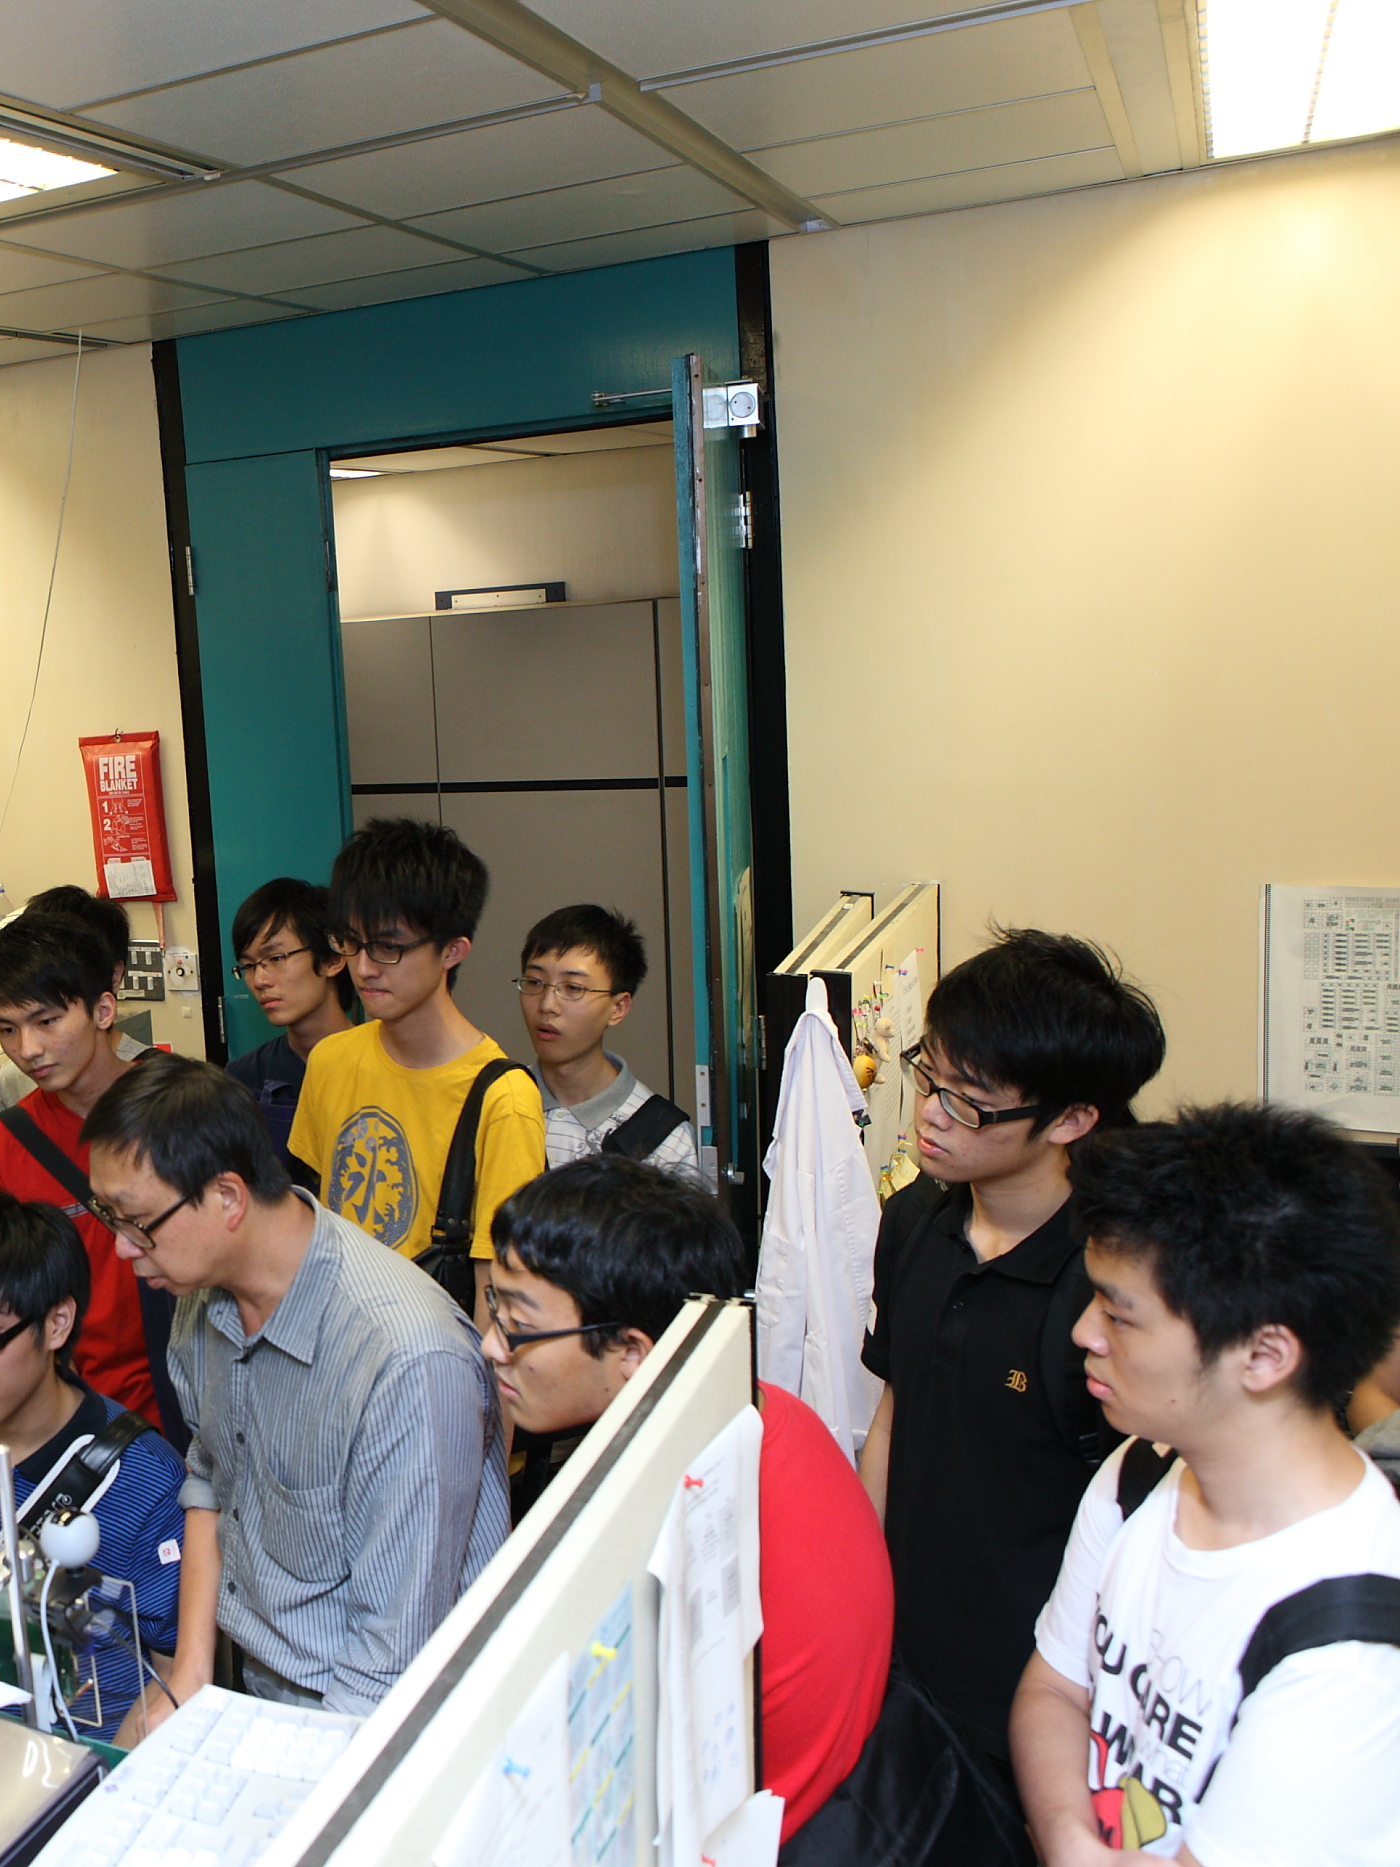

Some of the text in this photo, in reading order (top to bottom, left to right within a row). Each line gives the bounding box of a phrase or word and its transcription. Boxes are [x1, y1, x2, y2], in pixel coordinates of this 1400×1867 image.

[99, 755, 137, 780] FIRE
[100, 779, 138, 792] BLANKET
[102, 801, 109, 813] 1
[103, 818, 112, 831] 2
